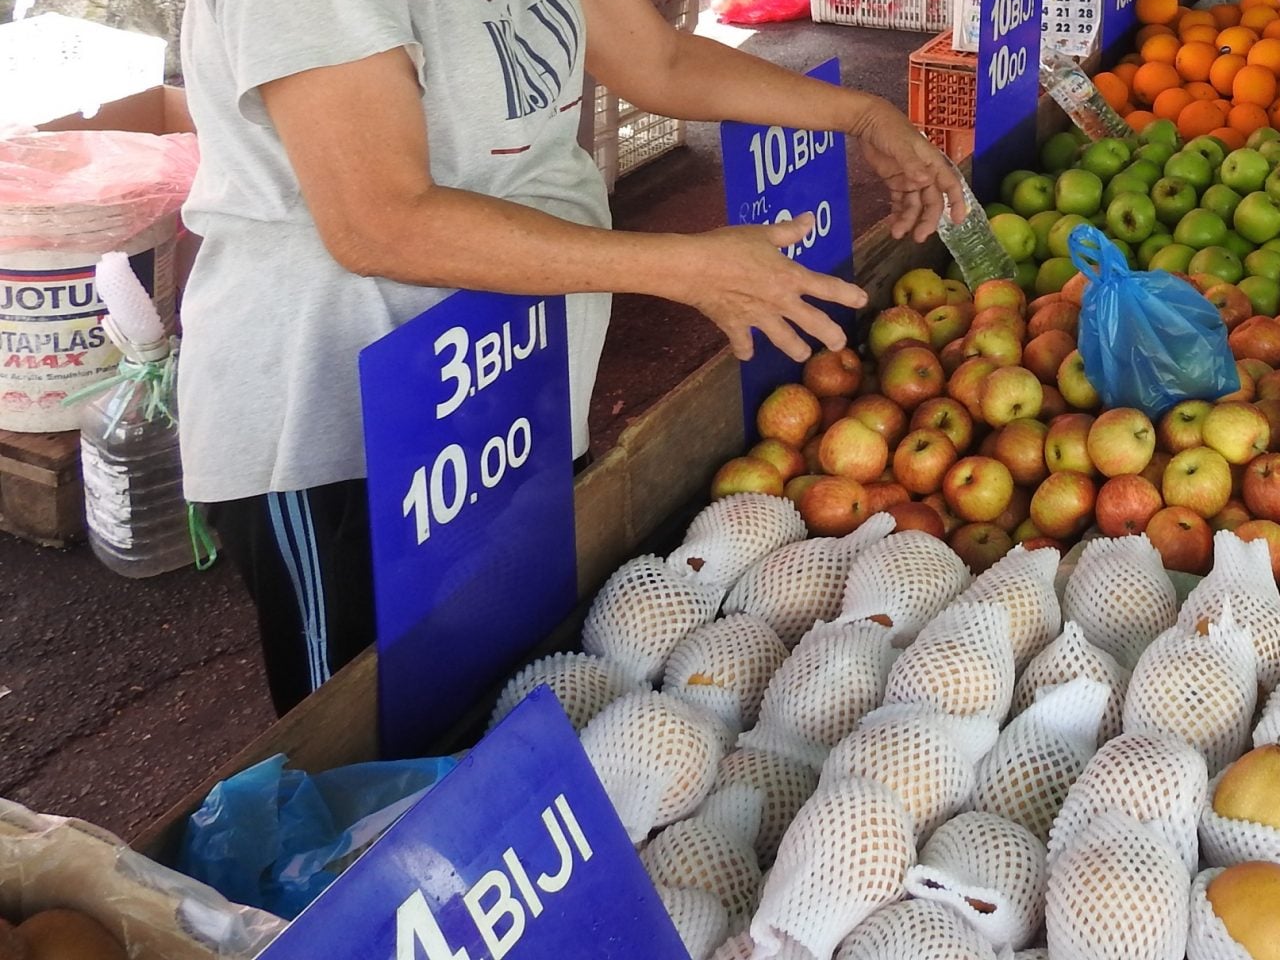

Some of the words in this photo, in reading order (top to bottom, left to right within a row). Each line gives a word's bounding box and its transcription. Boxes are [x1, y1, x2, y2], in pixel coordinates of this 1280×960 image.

[1056, 7, 1070, 18] 21
[1078, 8, 1094, 19] 28
[1056, 23, 1071, 33] 22
[1078, 24, 1093, 34] 29
[0, 282, 104, 311] JOTU
[434, 300, 548, 420] 3.BIJI
[403, 417, 532, 546] 10.00
[396, 793, 594, 960] 4BIJI
